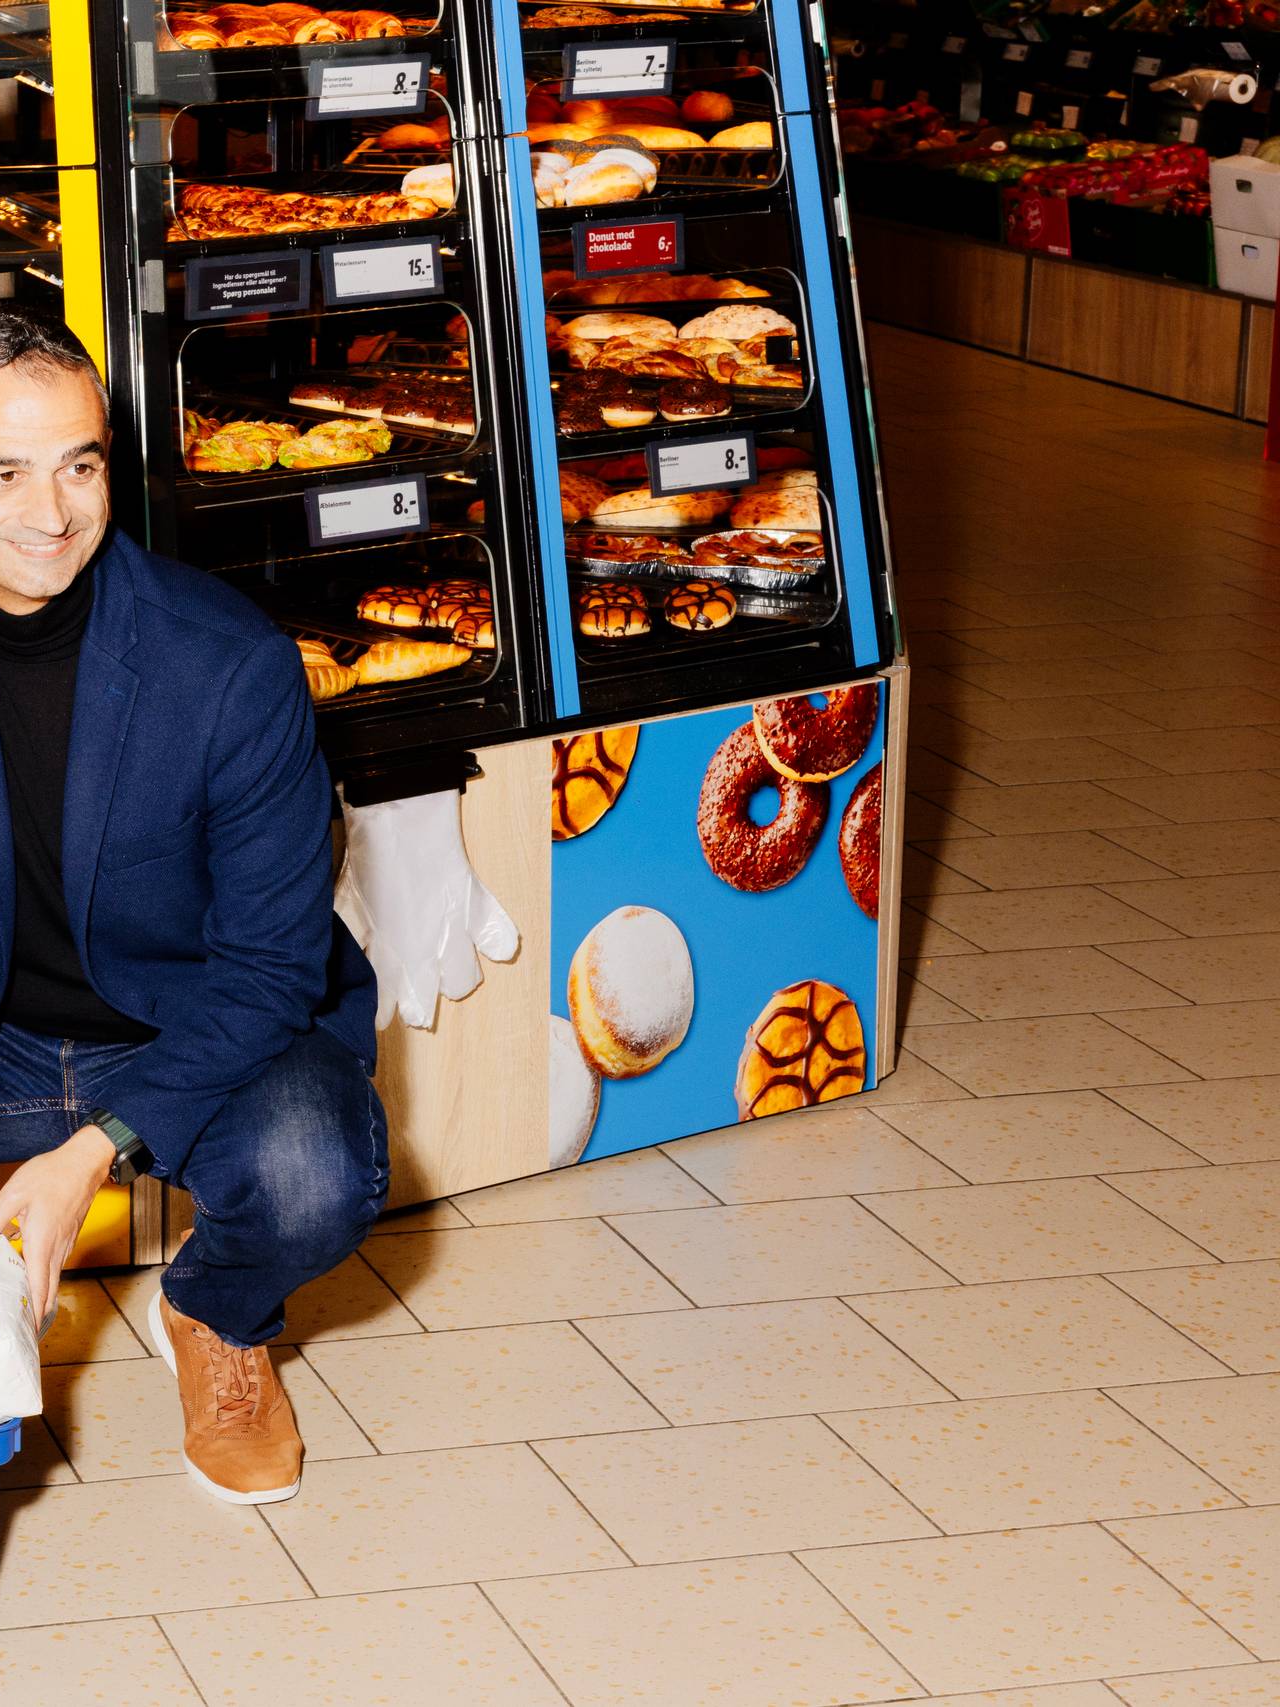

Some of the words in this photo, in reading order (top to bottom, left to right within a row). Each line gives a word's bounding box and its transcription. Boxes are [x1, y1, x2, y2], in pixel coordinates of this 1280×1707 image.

[642, 54, 665, 77] 7.-
[392, 72, 418, 94] 8.-
[588, 232, 615, 242] Donut
[617, 229, 635, 240] med
[589, 241, 632, 253] chokolade
[408, 258, 431, 277] 15.-
[223, 290, 242, 299] Spørg
[243, 286, 277, 298] personalet
[725, 448, 746, 470] 8.-
[393, 492, 417, 515] 8.-
